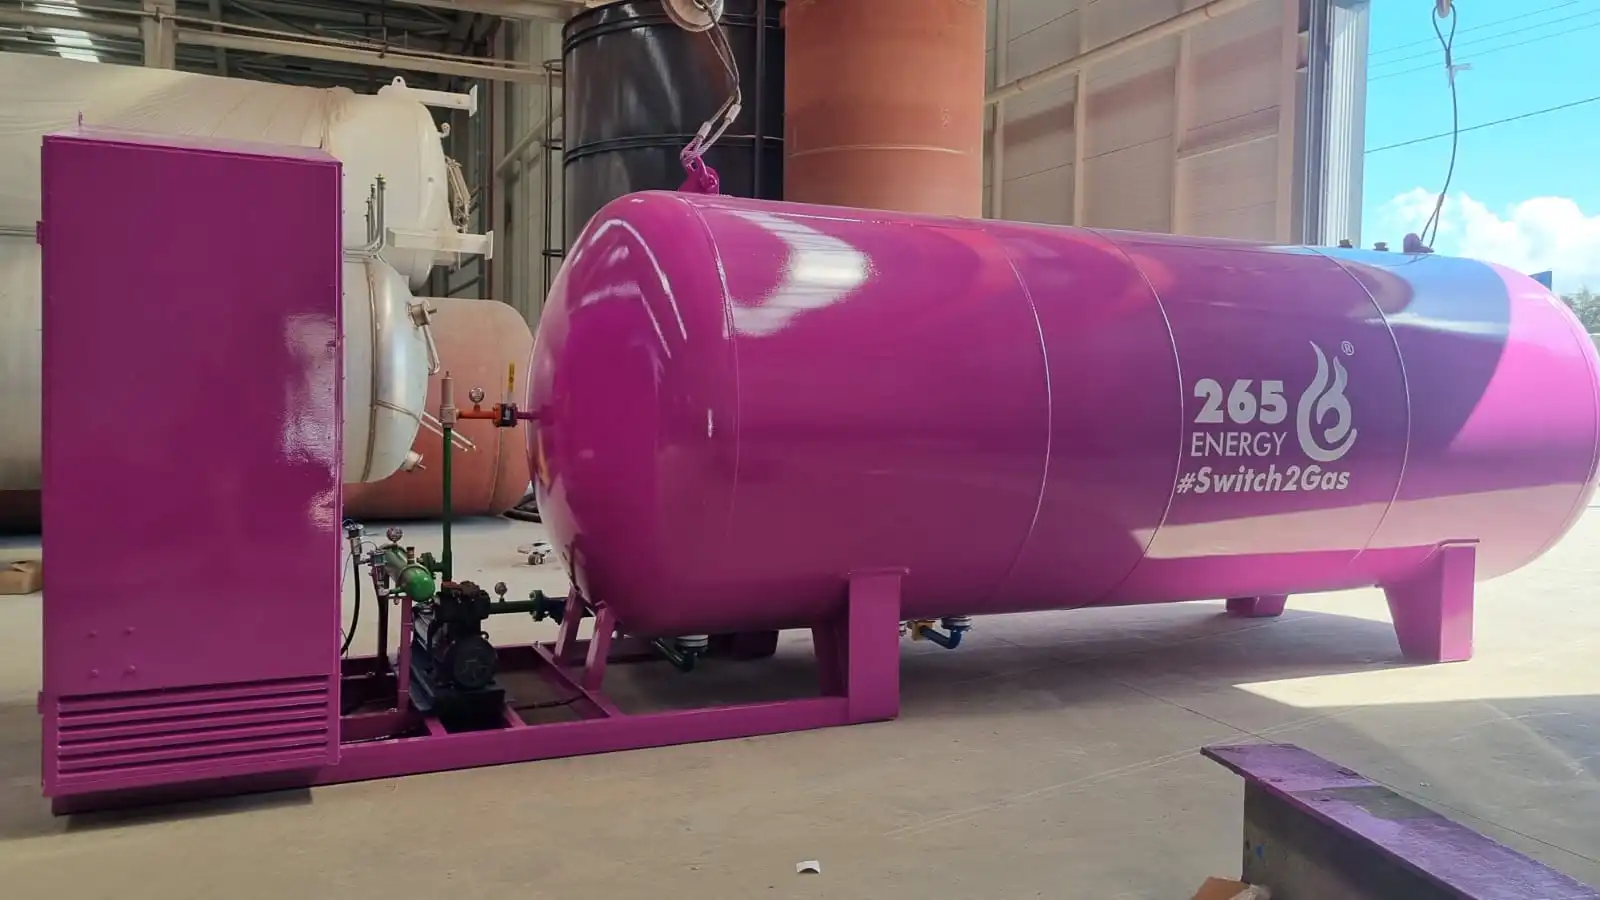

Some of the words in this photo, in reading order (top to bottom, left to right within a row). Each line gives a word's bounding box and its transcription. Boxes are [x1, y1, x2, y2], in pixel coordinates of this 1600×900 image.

[1193, 378, 1288, 425] 265
[1190, 431, 1288, 457] ENERGY
[1177, 464, 1350, 494] #Switch2Gas
